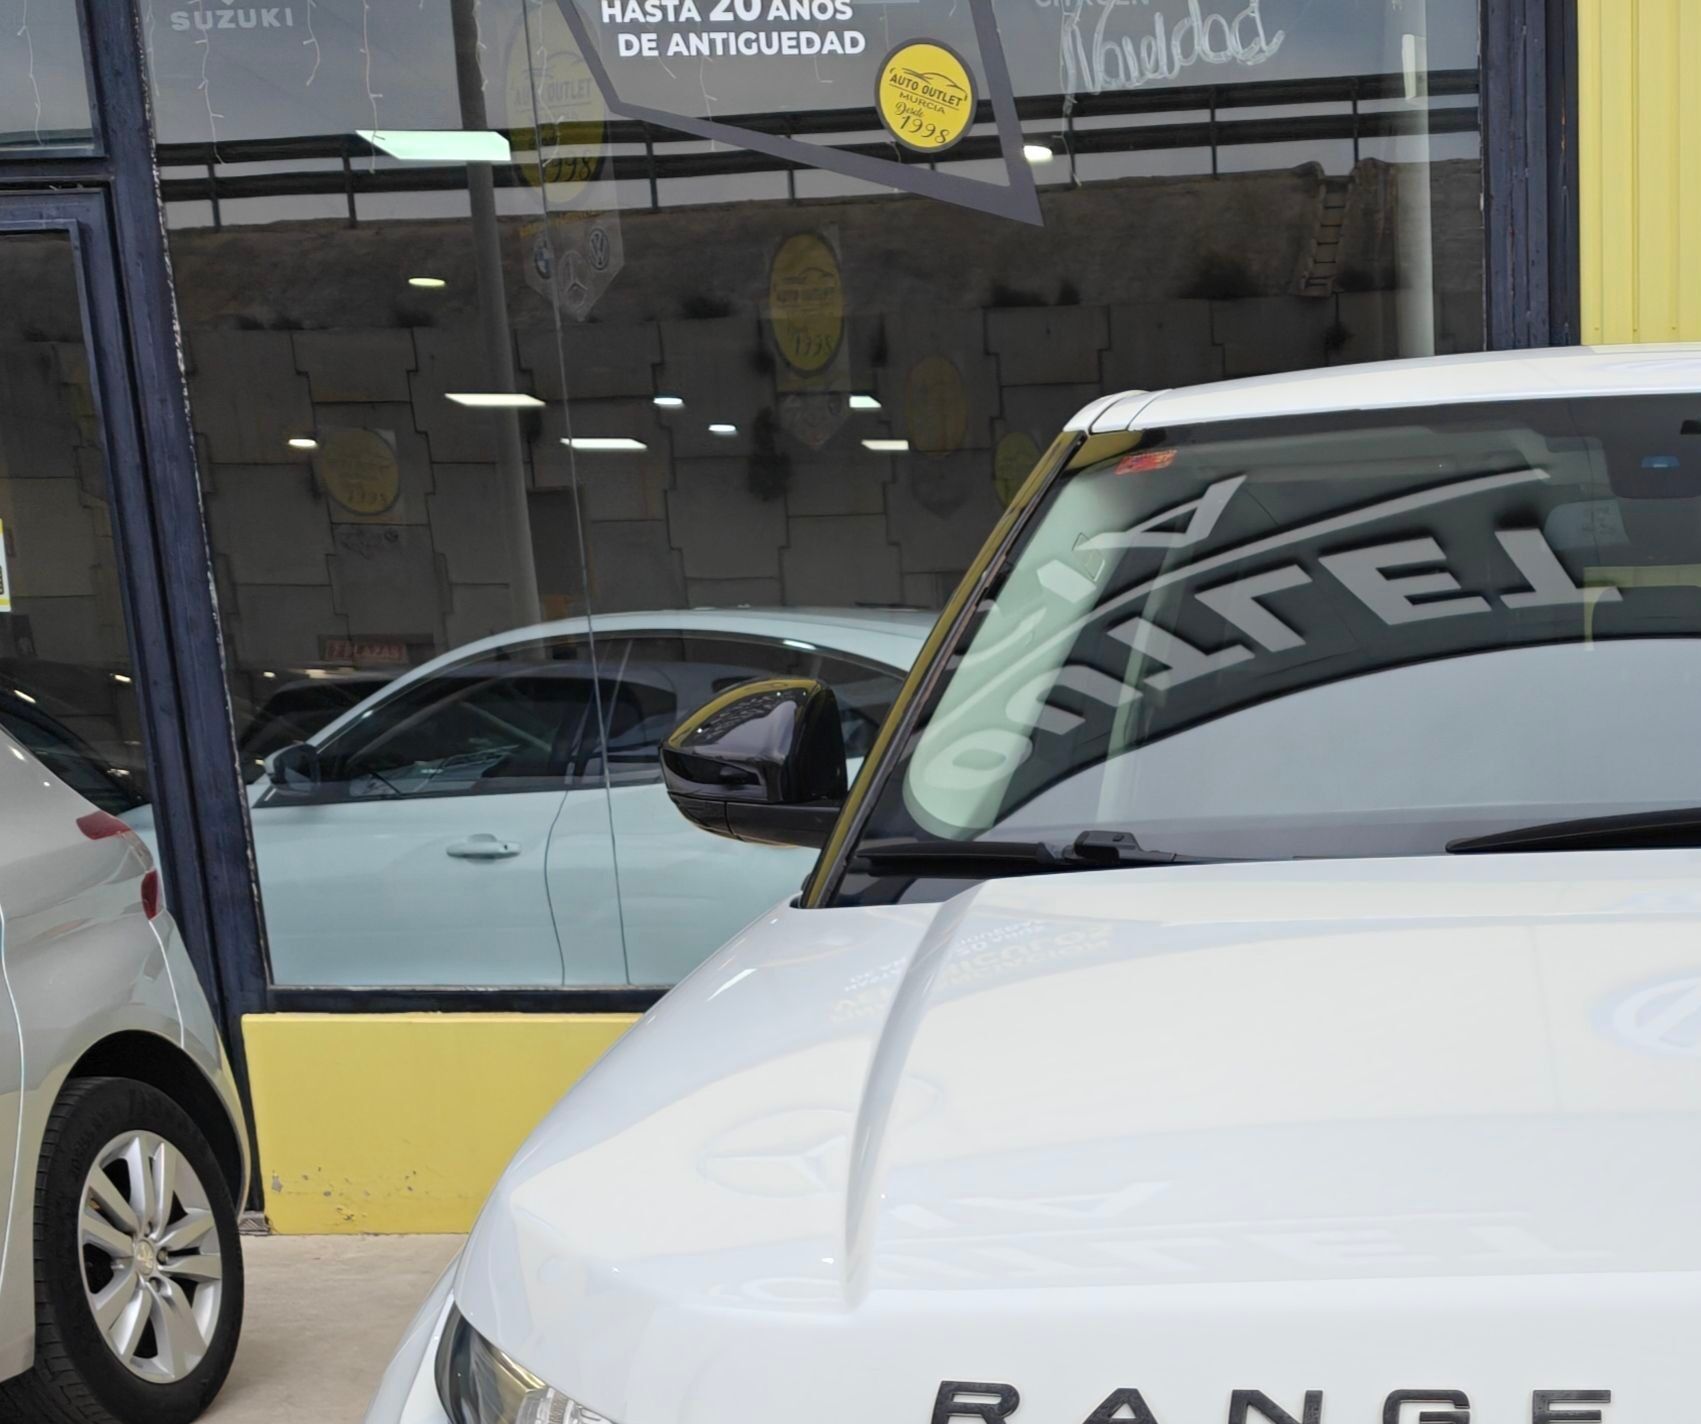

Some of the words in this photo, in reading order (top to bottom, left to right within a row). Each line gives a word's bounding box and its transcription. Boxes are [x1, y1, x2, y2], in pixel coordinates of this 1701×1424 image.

[170, 8, 294, 32] SUZUKI
[601, 0, 701, 23] HASTA
[618, 33, 658, 57] DE
[666, 31, 866, 56] ANTIGUEDAD
[890, 73, 919, 91] AUTO
[921, 84, 963, 107] OUTLET
[899, 91, 946, 115] MURCIA
[900, 115, 950, 144] 1998
